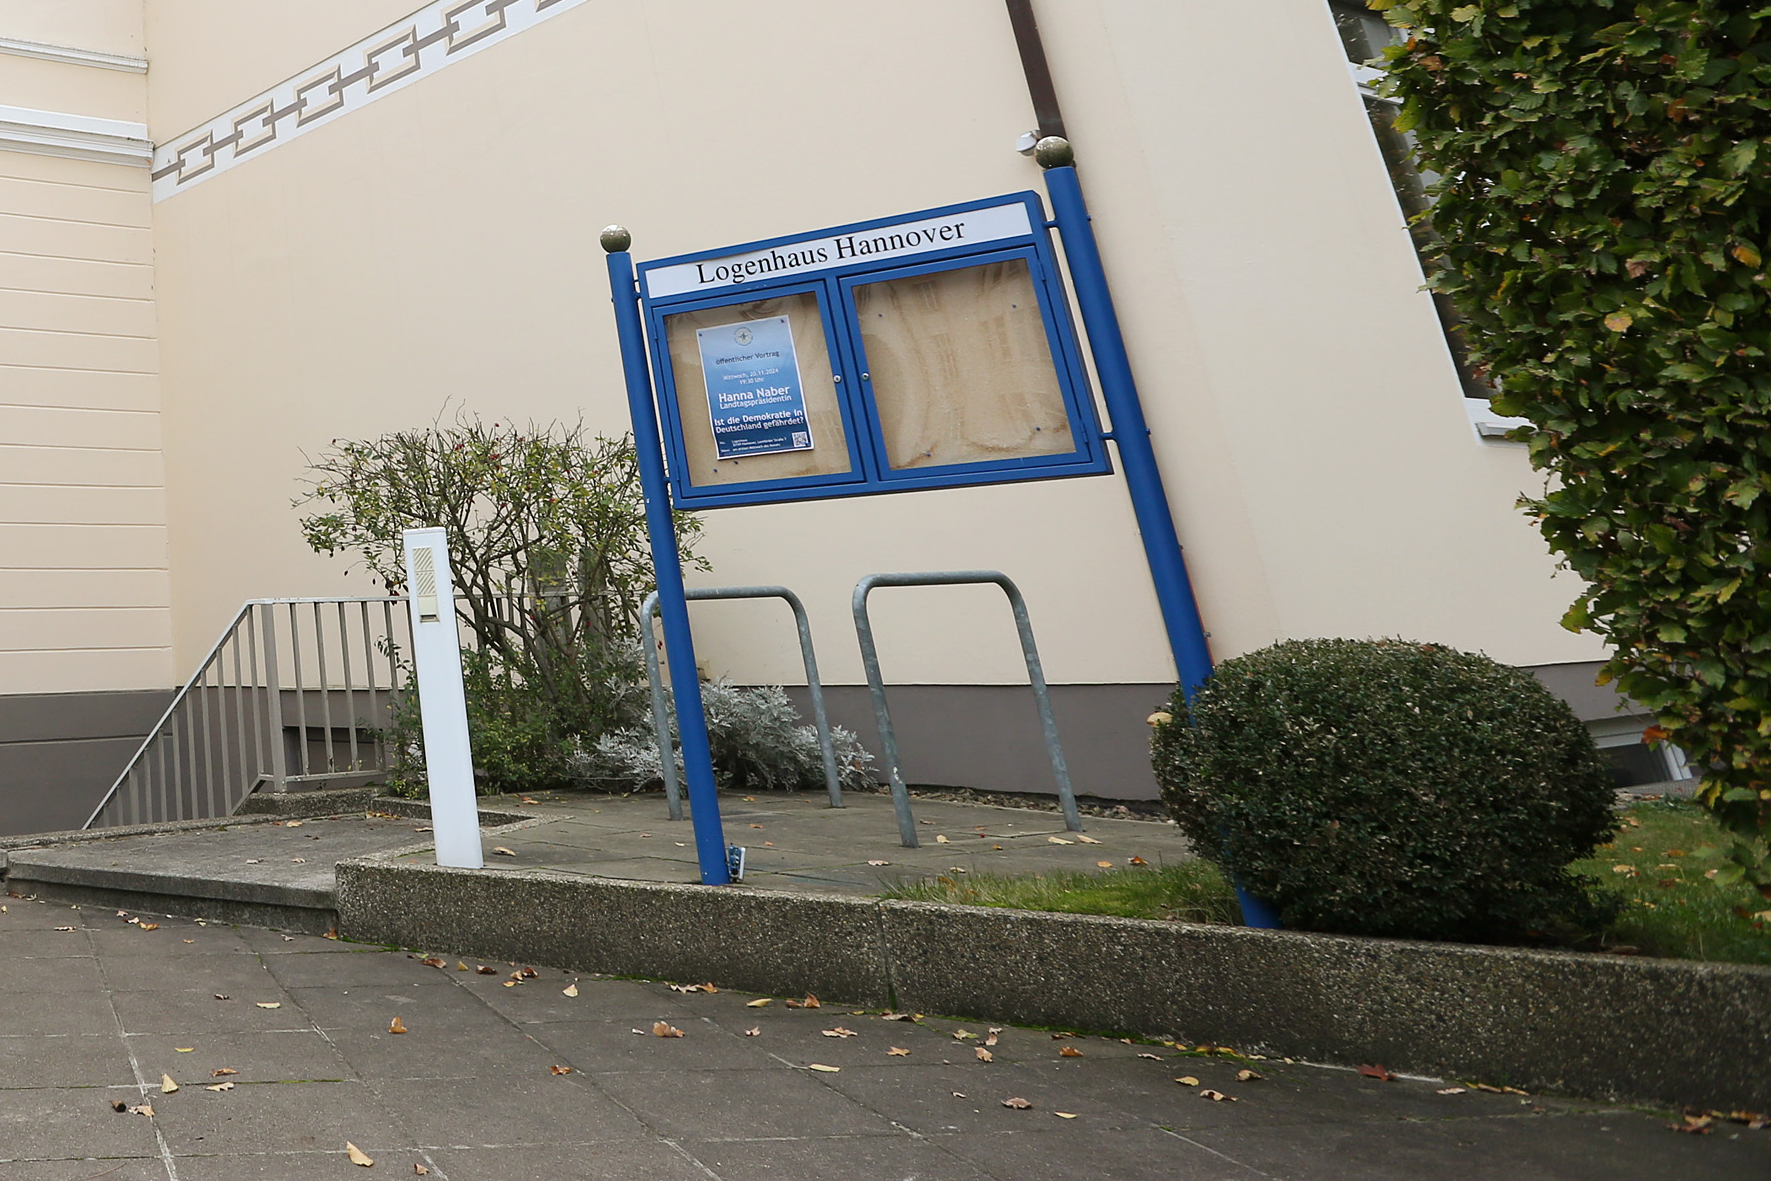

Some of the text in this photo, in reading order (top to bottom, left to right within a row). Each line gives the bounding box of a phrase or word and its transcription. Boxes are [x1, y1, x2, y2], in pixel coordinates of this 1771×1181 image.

[696, 222, 966, 284] Logenhaus Hannover
[754, 350, 780, 359] Vortrag
[749, 368, 779, 377] 20.11.2024
[718, 386, 790, 403] Hanna Naber
[719, 395, 792, 410] Landtagspräsidentin
[714, 408, 803, 426] Ist die Demokratie in
[715, 416, 804, 434] Deutschland gefährdet?
